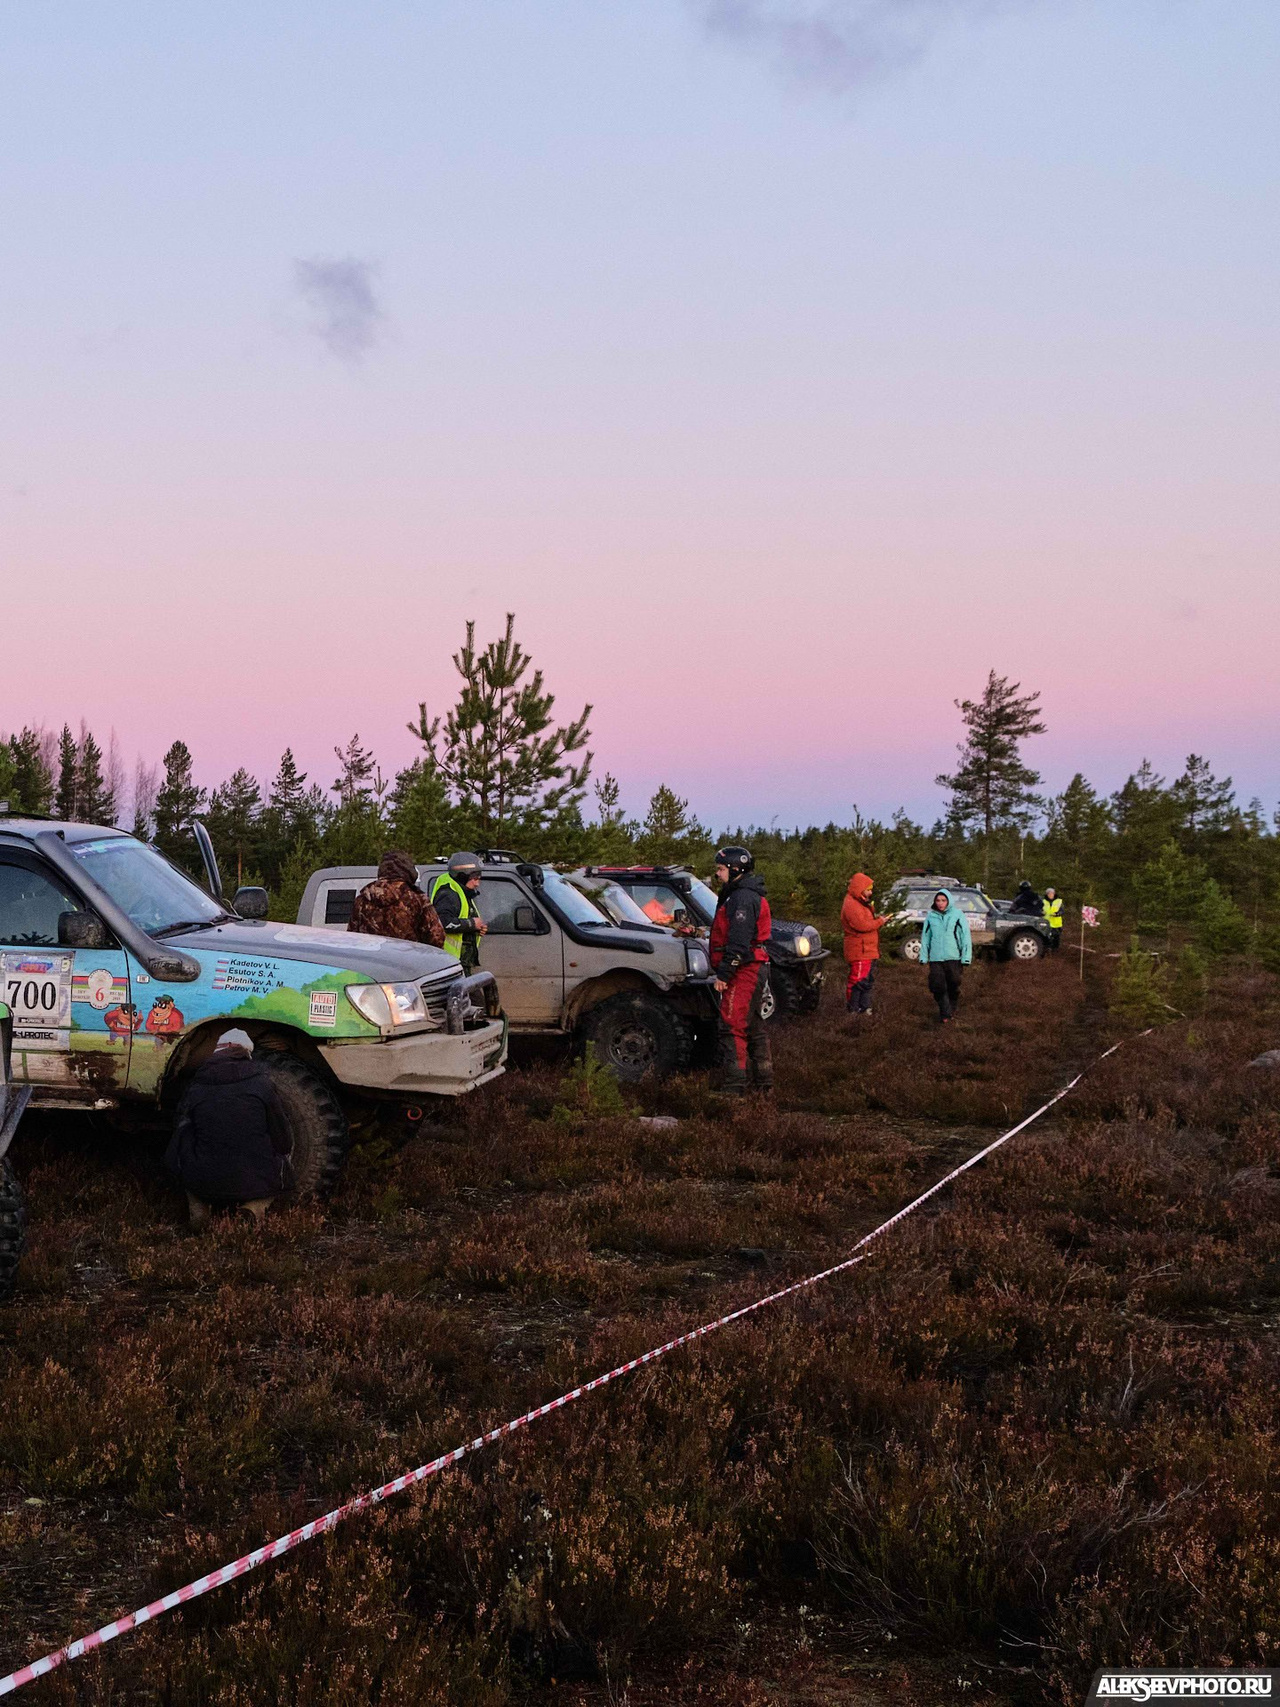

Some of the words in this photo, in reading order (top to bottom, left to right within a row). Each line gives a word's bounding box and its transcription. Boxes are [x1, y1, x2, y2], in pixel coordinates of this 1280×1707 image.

[230, 959, 263, 968] Kadetov
[228, 968, 256, 977] Esutov
[267, 971, 276, 979] A.
[226, 976, 264, 985] Plotnikov
[224, 984, 250, 992] Petrov
[7, 980, 56, 1010] 700
[95, 987, 104, 1001] 6
[314, 994, 334, 1004] AUTO
[15, 1031, 54, 1040] SUPROTEC
